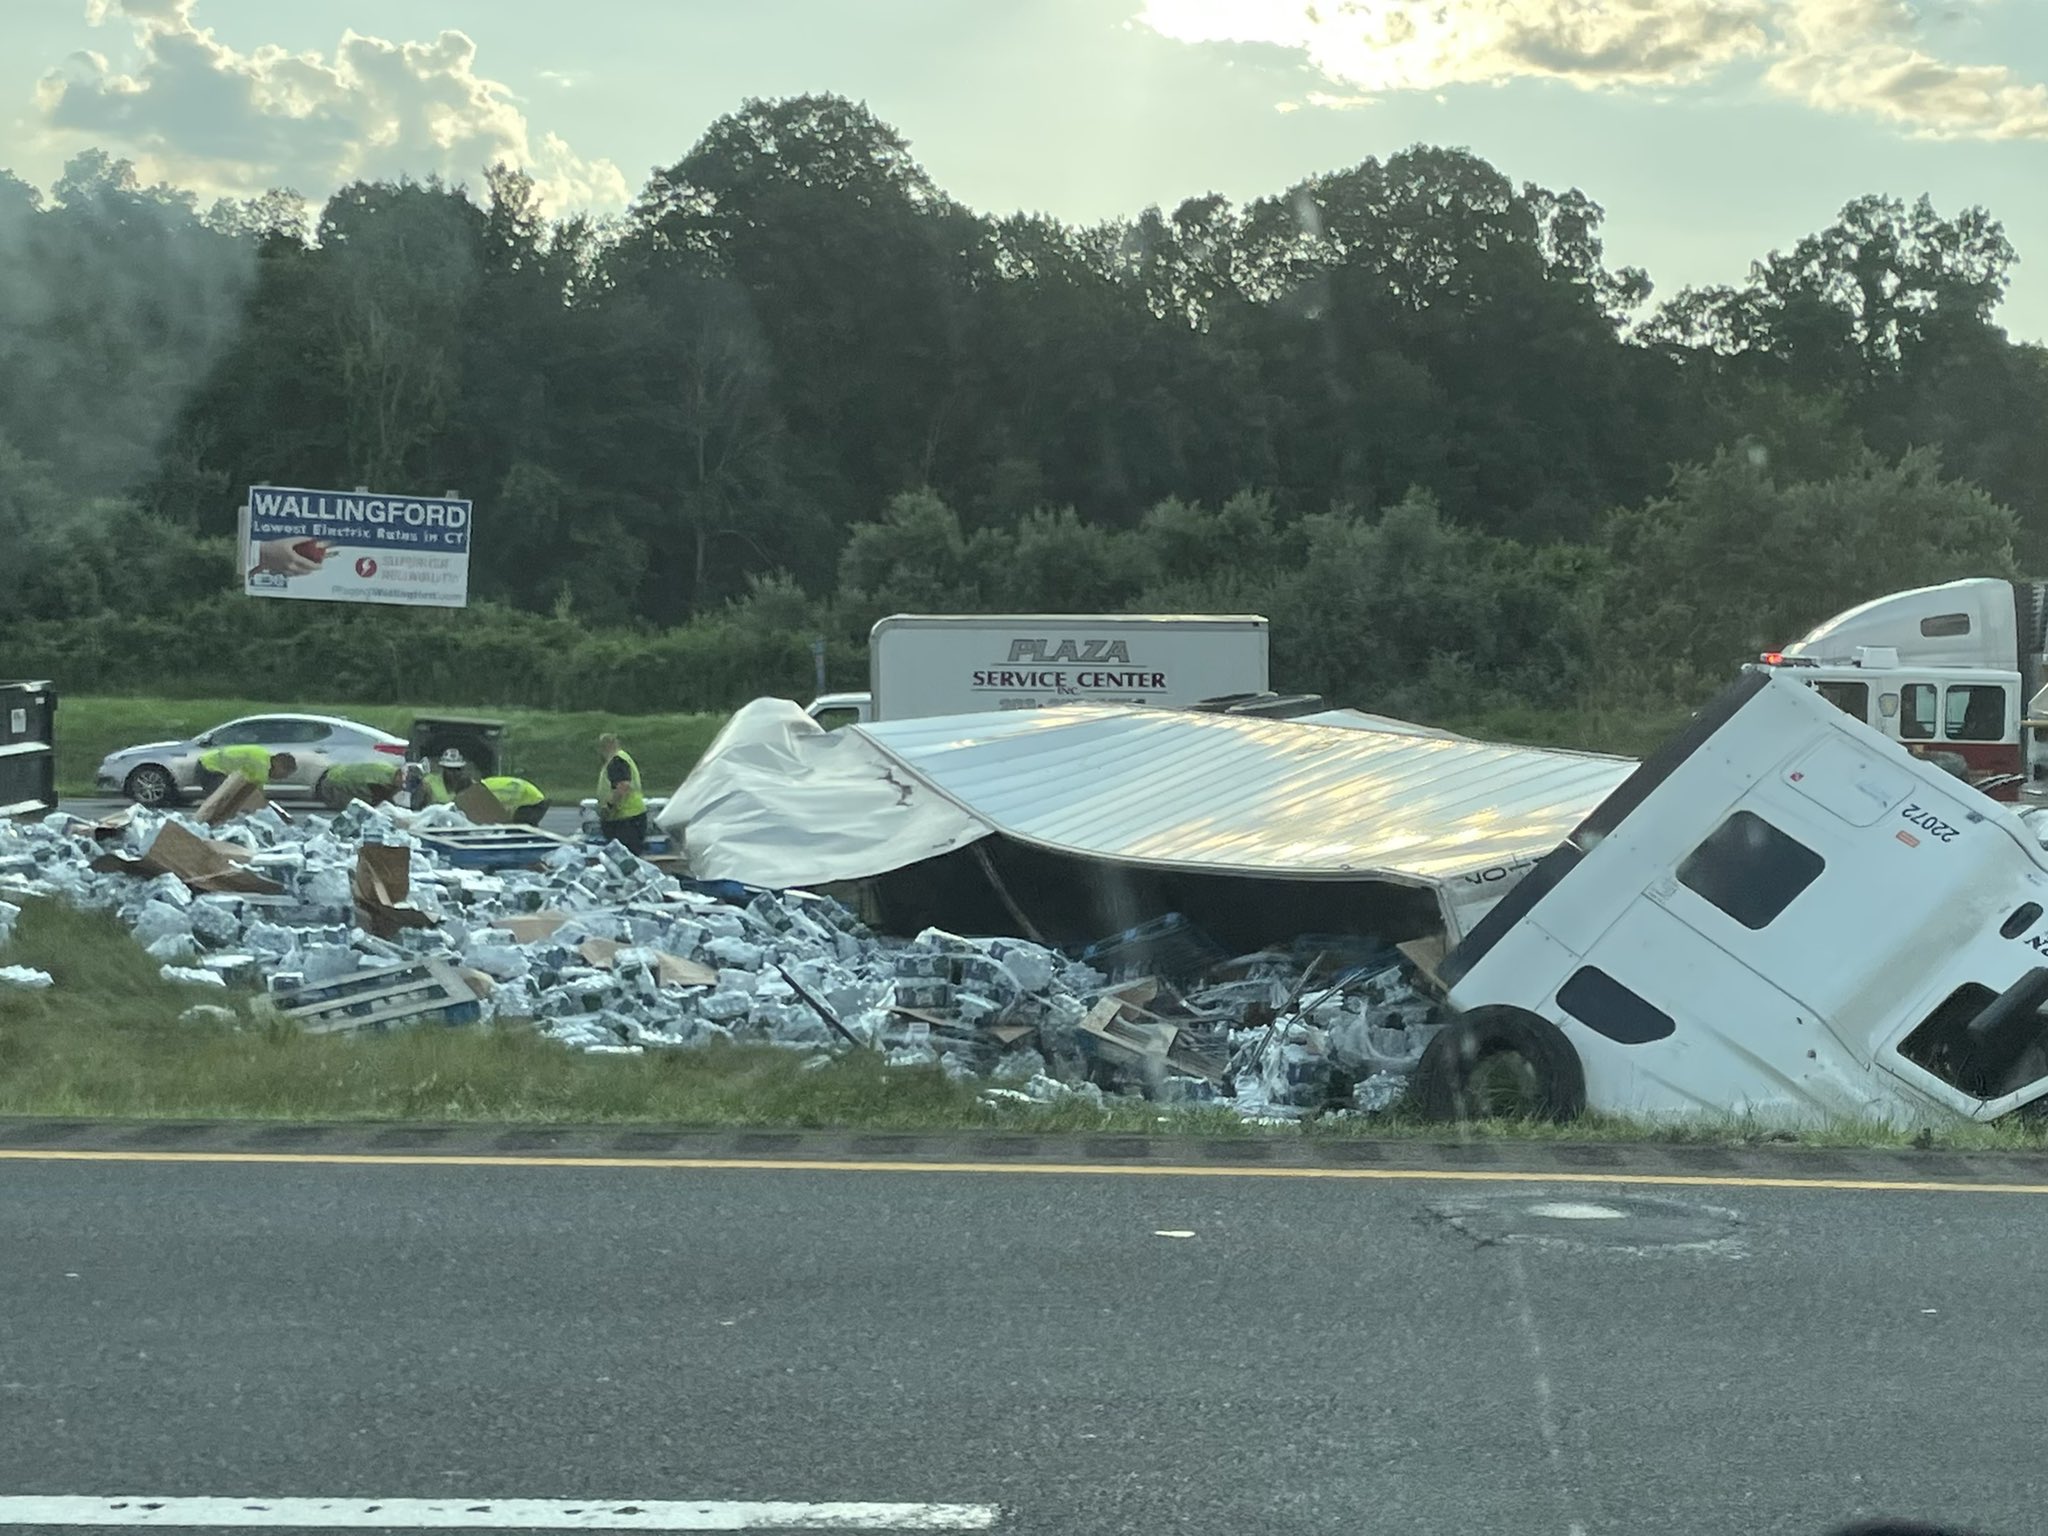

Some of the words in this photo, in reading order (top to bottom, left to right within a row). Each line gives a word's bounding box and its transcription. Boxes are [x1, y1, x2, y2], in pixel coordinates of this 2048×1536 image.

[255, 494, 466, 528] WALLINGFORD
[254, 520, 306, 534] Lowest
[313, 523, 371, 539] Electric
[377, 527, 418, 542] Rates
[424, 529, 438, 543] in
[444, 532, 464, 545] CT
[1007, 639, 1131, 663] PLAZA
[973, 671, 1067, 688] SERVICE
[1077, 671, 1166, 688] CENTER
[1902, 804, 1960, 843] 22072
